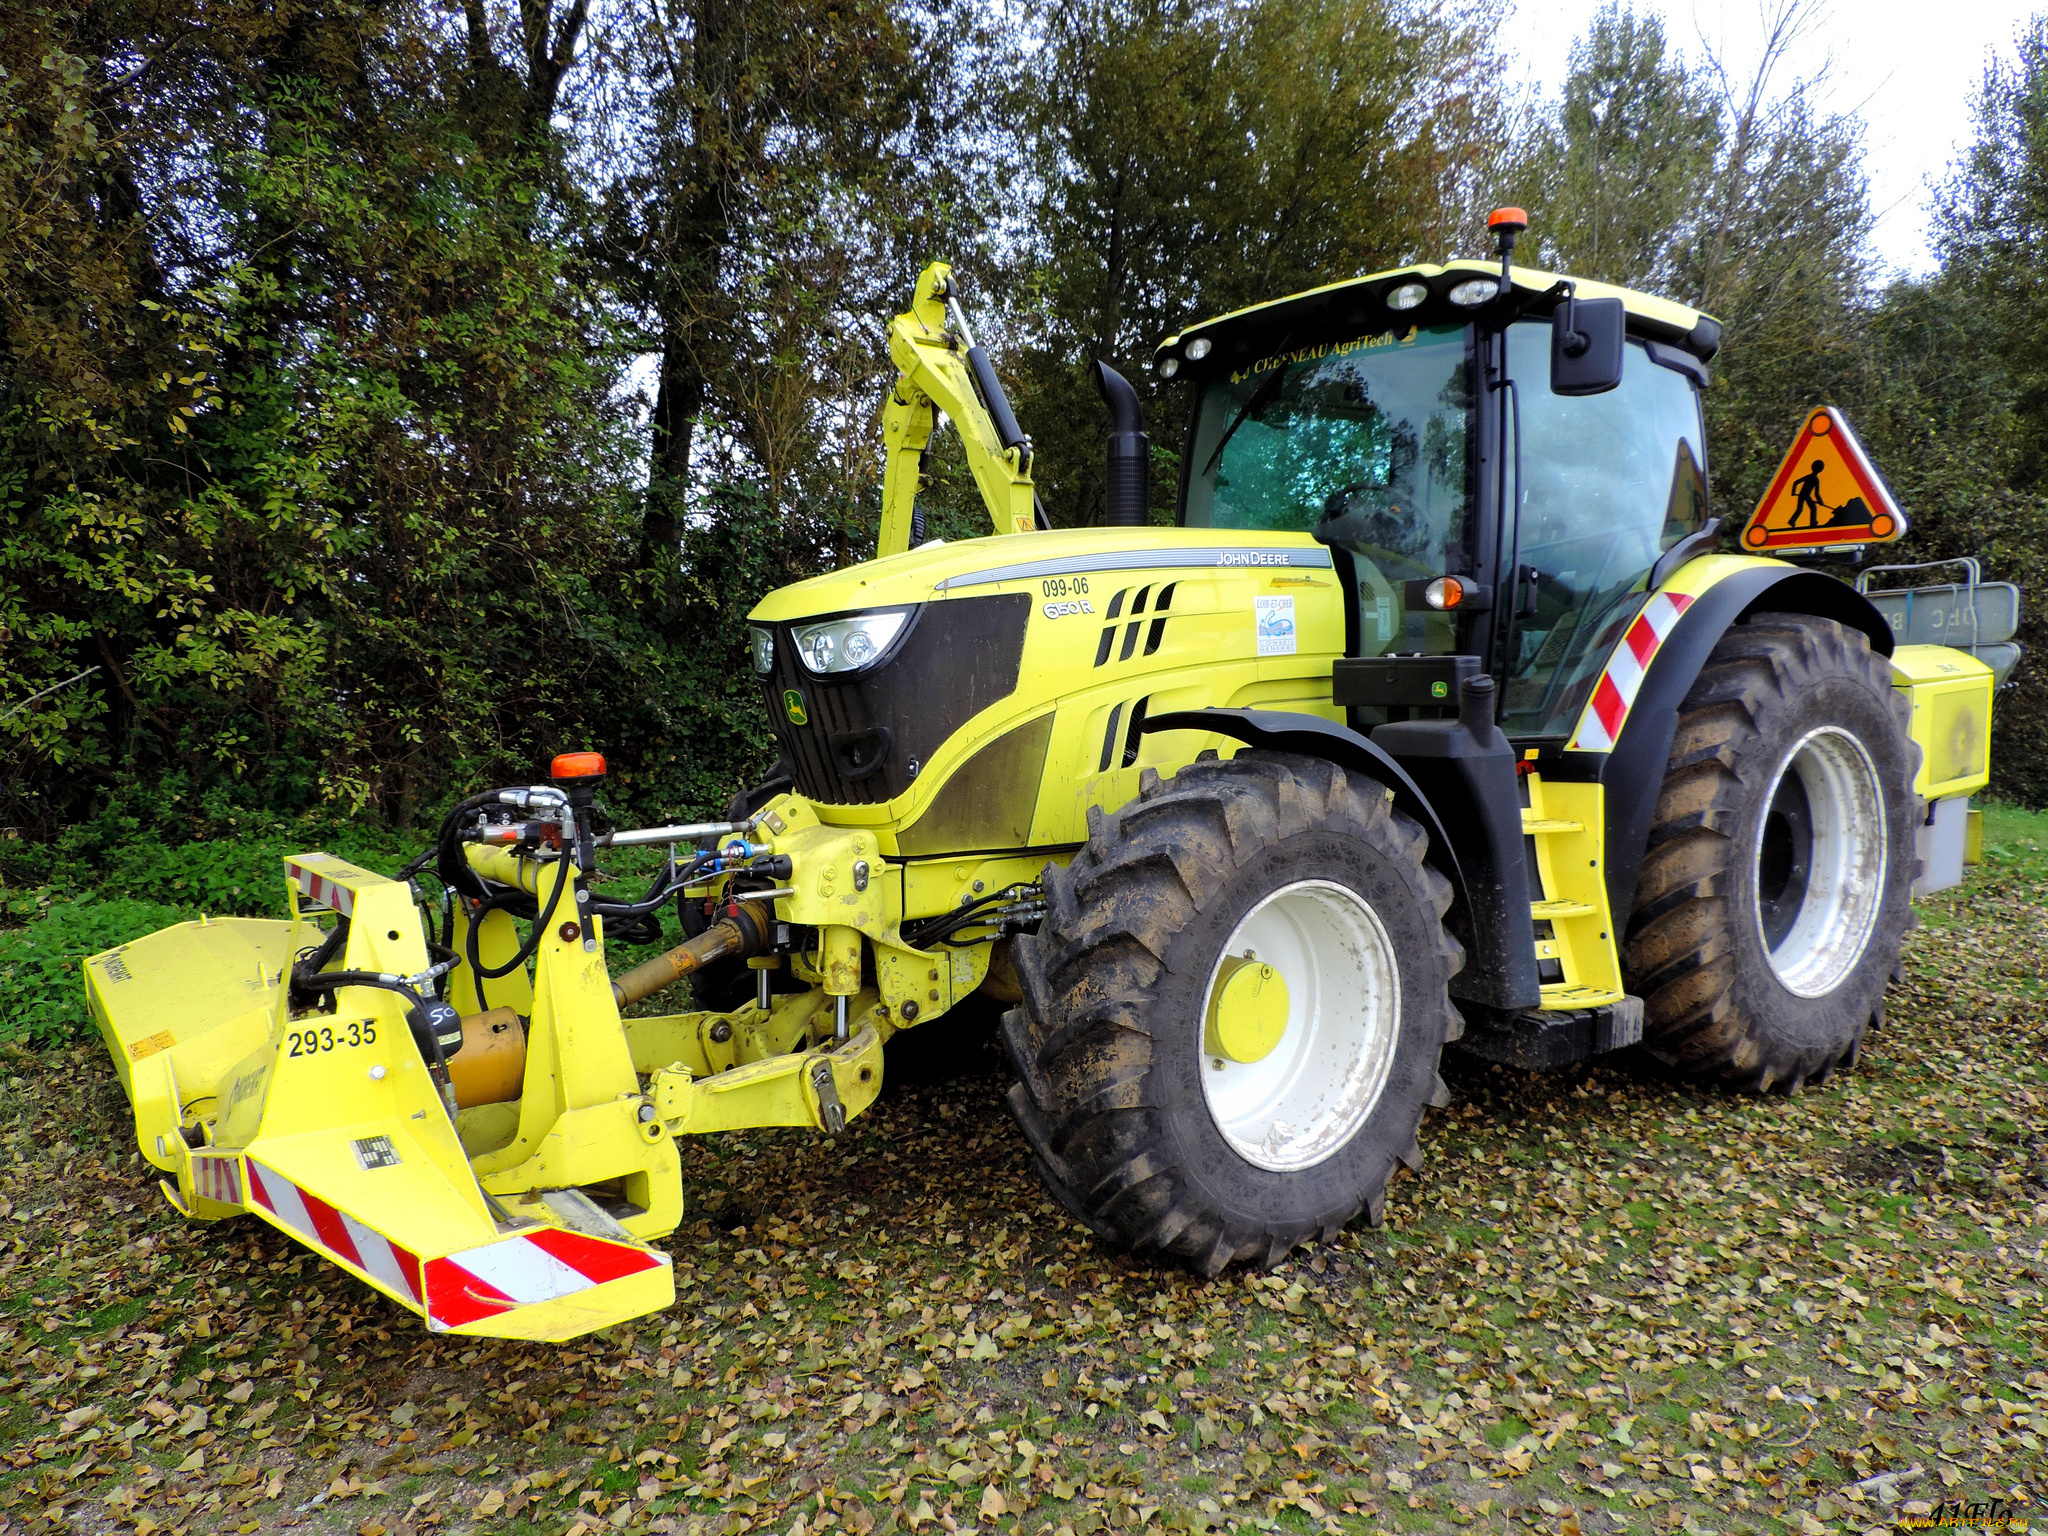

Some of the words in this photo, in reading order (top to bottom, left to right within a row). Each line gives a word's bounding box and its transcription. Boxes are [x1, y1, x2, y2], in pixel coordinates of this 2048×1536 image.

[1330, 331, 1393, 357] AgriTech
[1216, 551, 1250, 567] JOHN
[1250, 551, 1290, 567] DEERE
[1042, 576, 1089, 598] 099-06
[288, 1020, 377, 1058] 293-35
